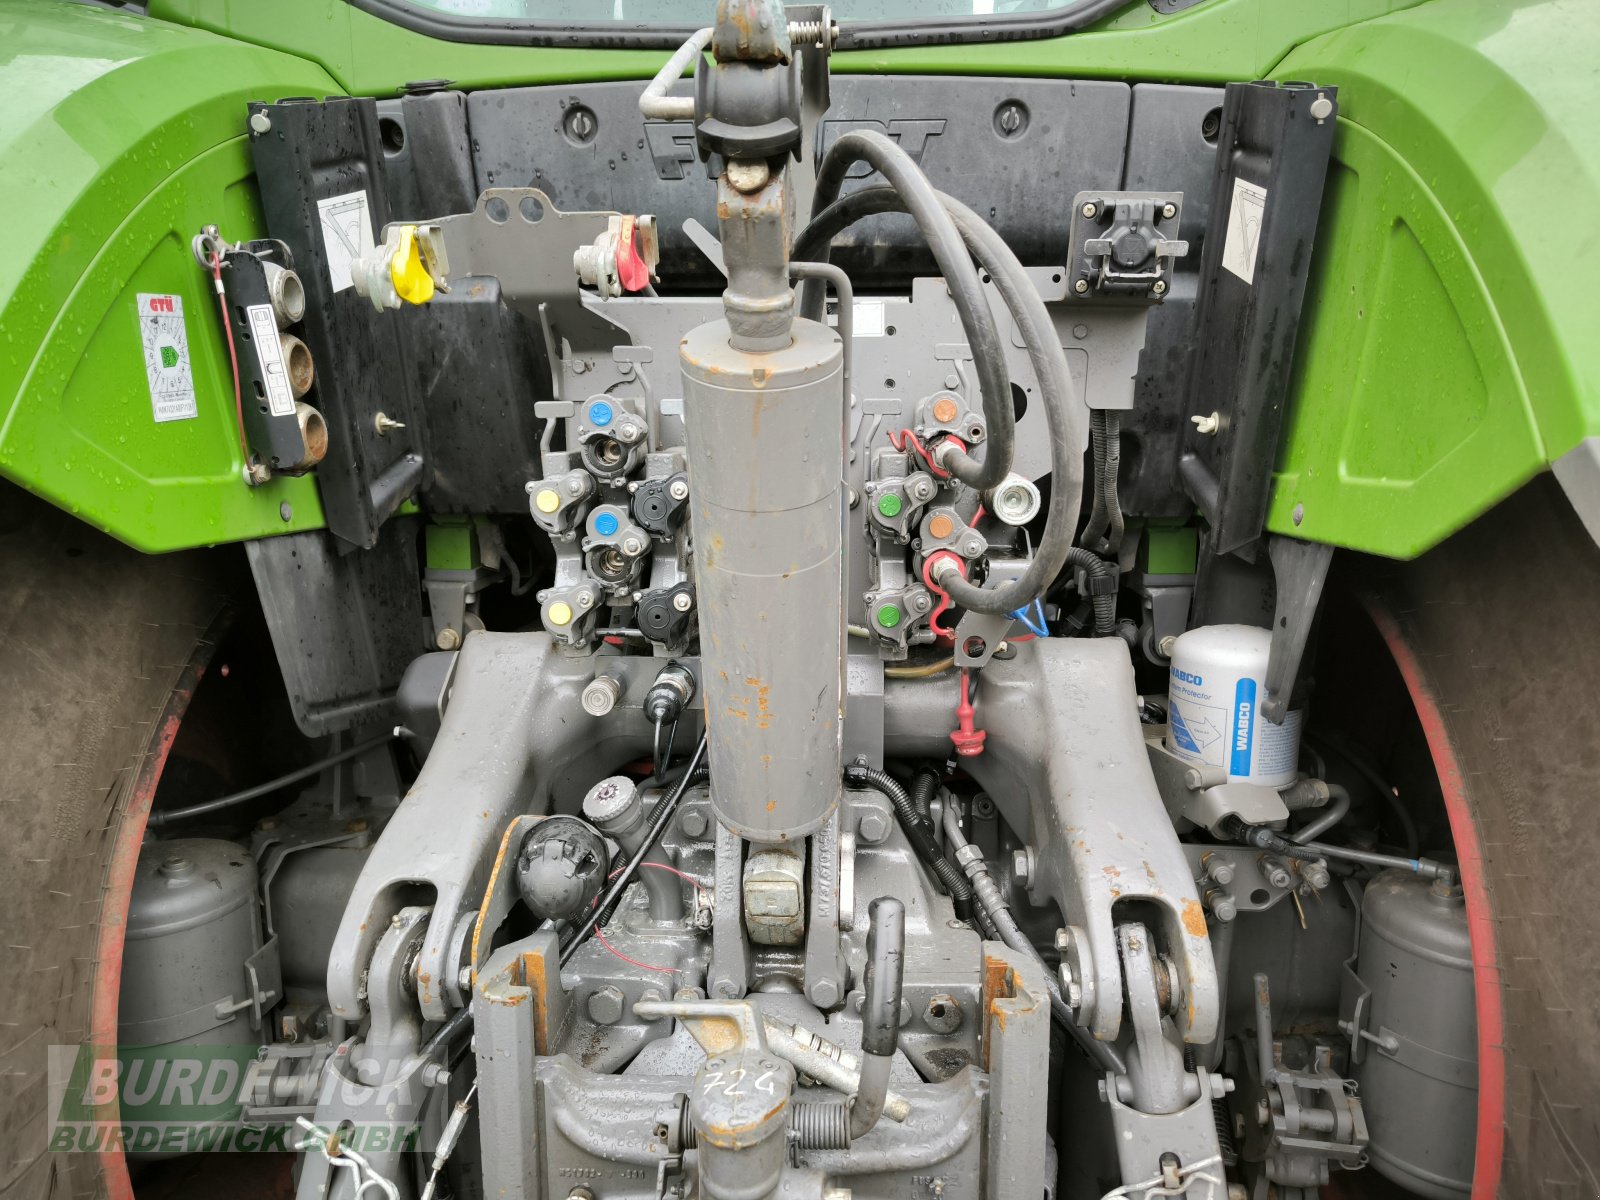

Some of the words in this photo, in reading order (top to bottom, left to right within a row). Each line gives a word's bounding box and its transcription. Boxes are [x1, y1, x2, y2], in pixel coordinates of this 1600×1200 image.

[149, 295, 174, 312] GTÜ
[1182, 687, 1212, 700] Protector
[1236, 702, 1251, 751] WABCO
